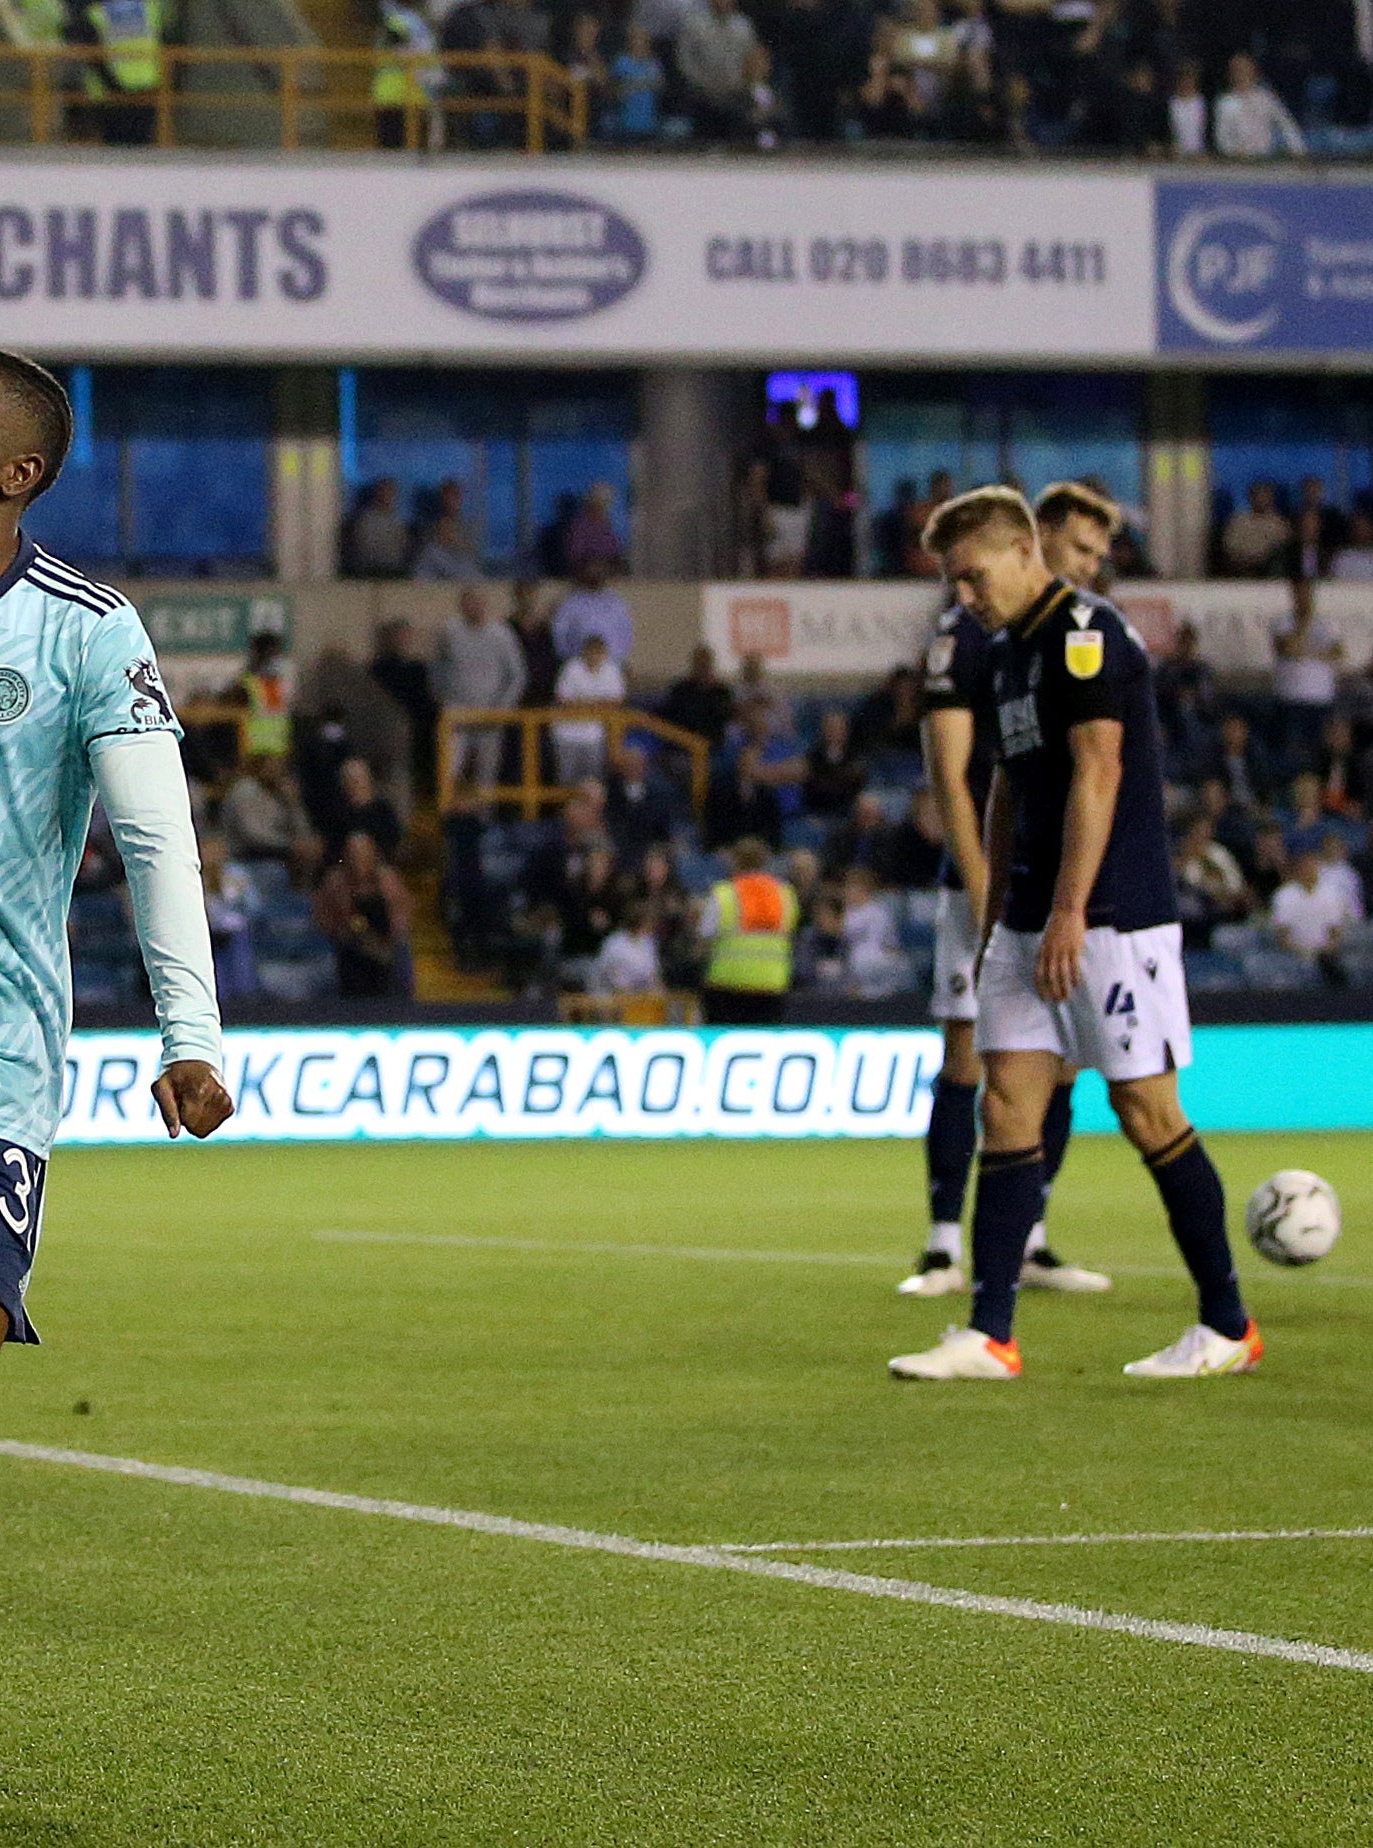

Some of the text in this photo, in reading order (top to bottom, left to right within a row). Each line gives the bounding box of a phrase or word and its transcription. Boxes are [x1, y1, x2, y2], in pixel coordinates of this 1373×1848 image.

[706, 236, 796, 282] CALL
[810, 236, 889, 283] 020
[1022, 237, 1106, 283] 4411
[145, 715, 165, 726] BIA
[1105, 982, 1135, 1015] 4
